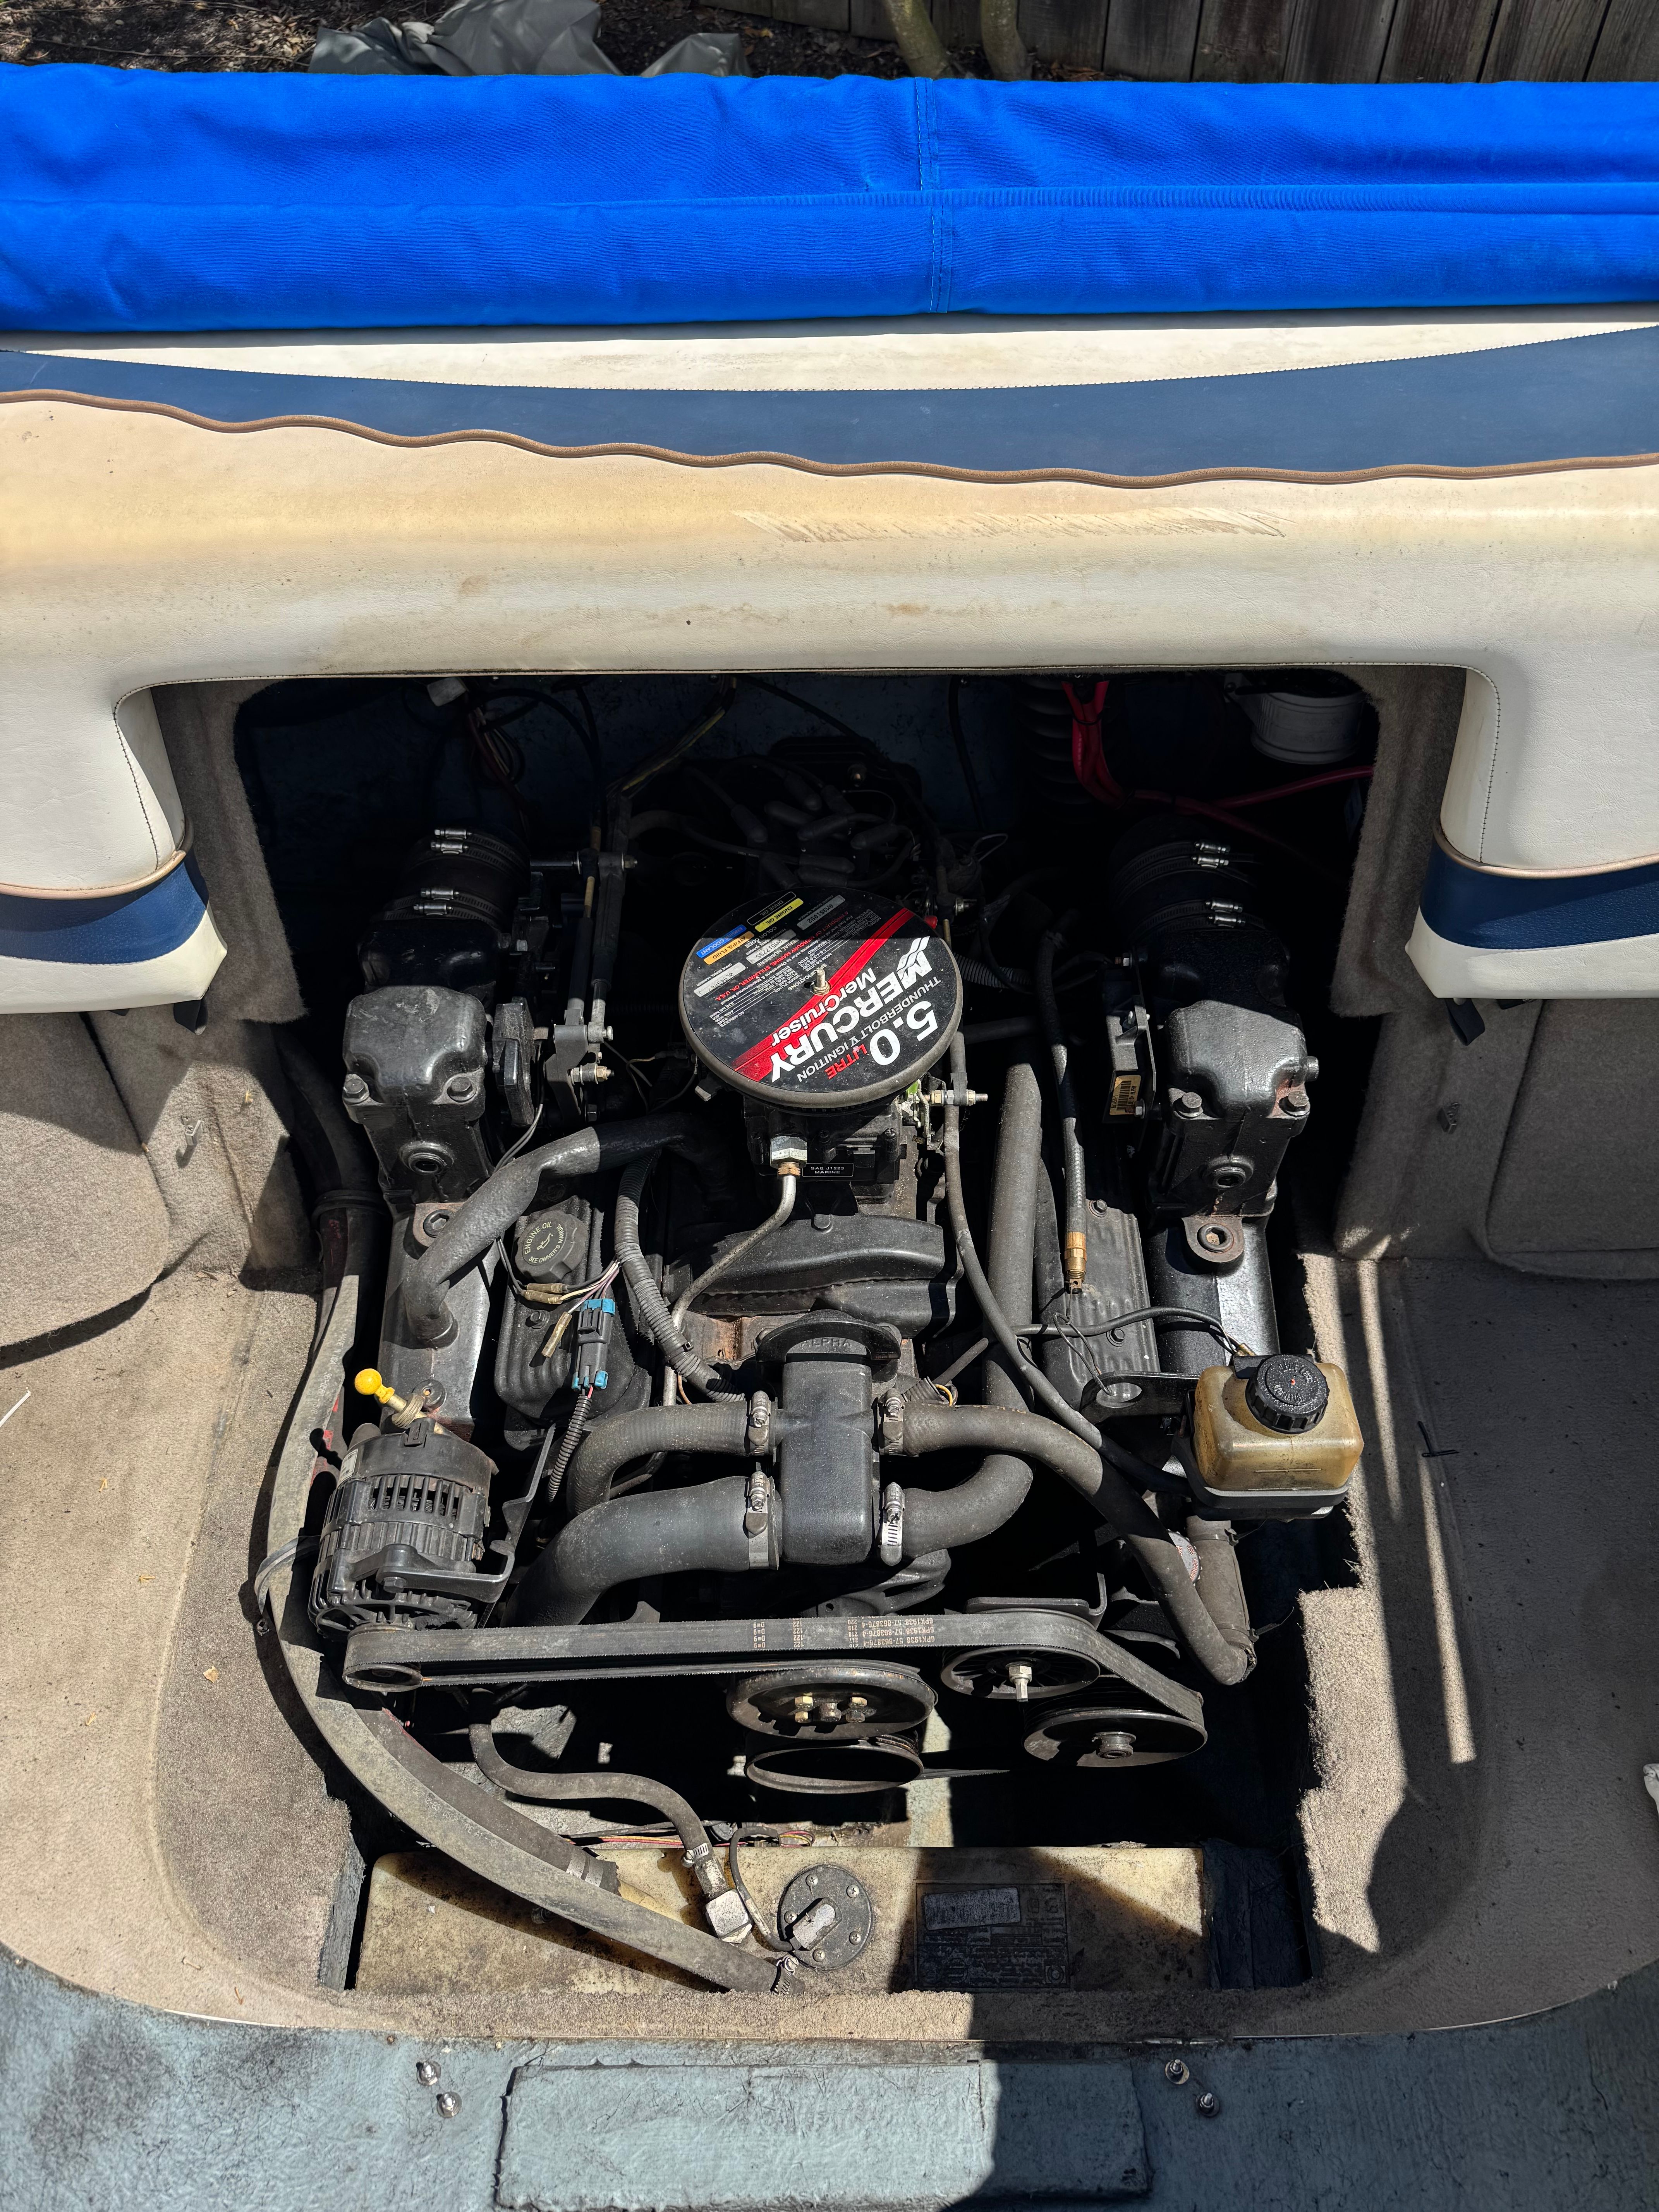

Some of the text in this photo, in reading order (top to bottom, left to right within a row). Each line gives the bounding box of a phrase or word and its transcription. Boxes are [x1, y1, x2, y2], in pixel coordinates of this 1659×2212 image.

[768, 900, 784, 911] DRIVE
[774, 905, 793, 919] ENGINE
[700, 927, 743, 955] ENGINE COOLANT
[744, 926, 777, 948] COLOR CODE
[711, 948, 727, 959] FLUID
[756, 938, 799, 967] SERIAL NUMBERS
[787, 963, 827, 991] SPECIFICATIONS
[769, 936, 932, 1082] MERCURY
[771, 967, 877, 1047] MerCruiser
[861, 976, 941, 1039] THUNDERBOLT
[824, 1000, 938, 1079] 5.0 LITRE
[797, 1042, 848, 1082] IGNITION
[525, 1226, 542, 1255] ENGINE
[539, 1245, 560, 1263] OWNER'S
[556, 1223, 564, 1243] MANUAL
[863, 1626, 934, 1637] 6PK1938 57-863876-4
[907, 1636, 935, 1644] 6PK1938
